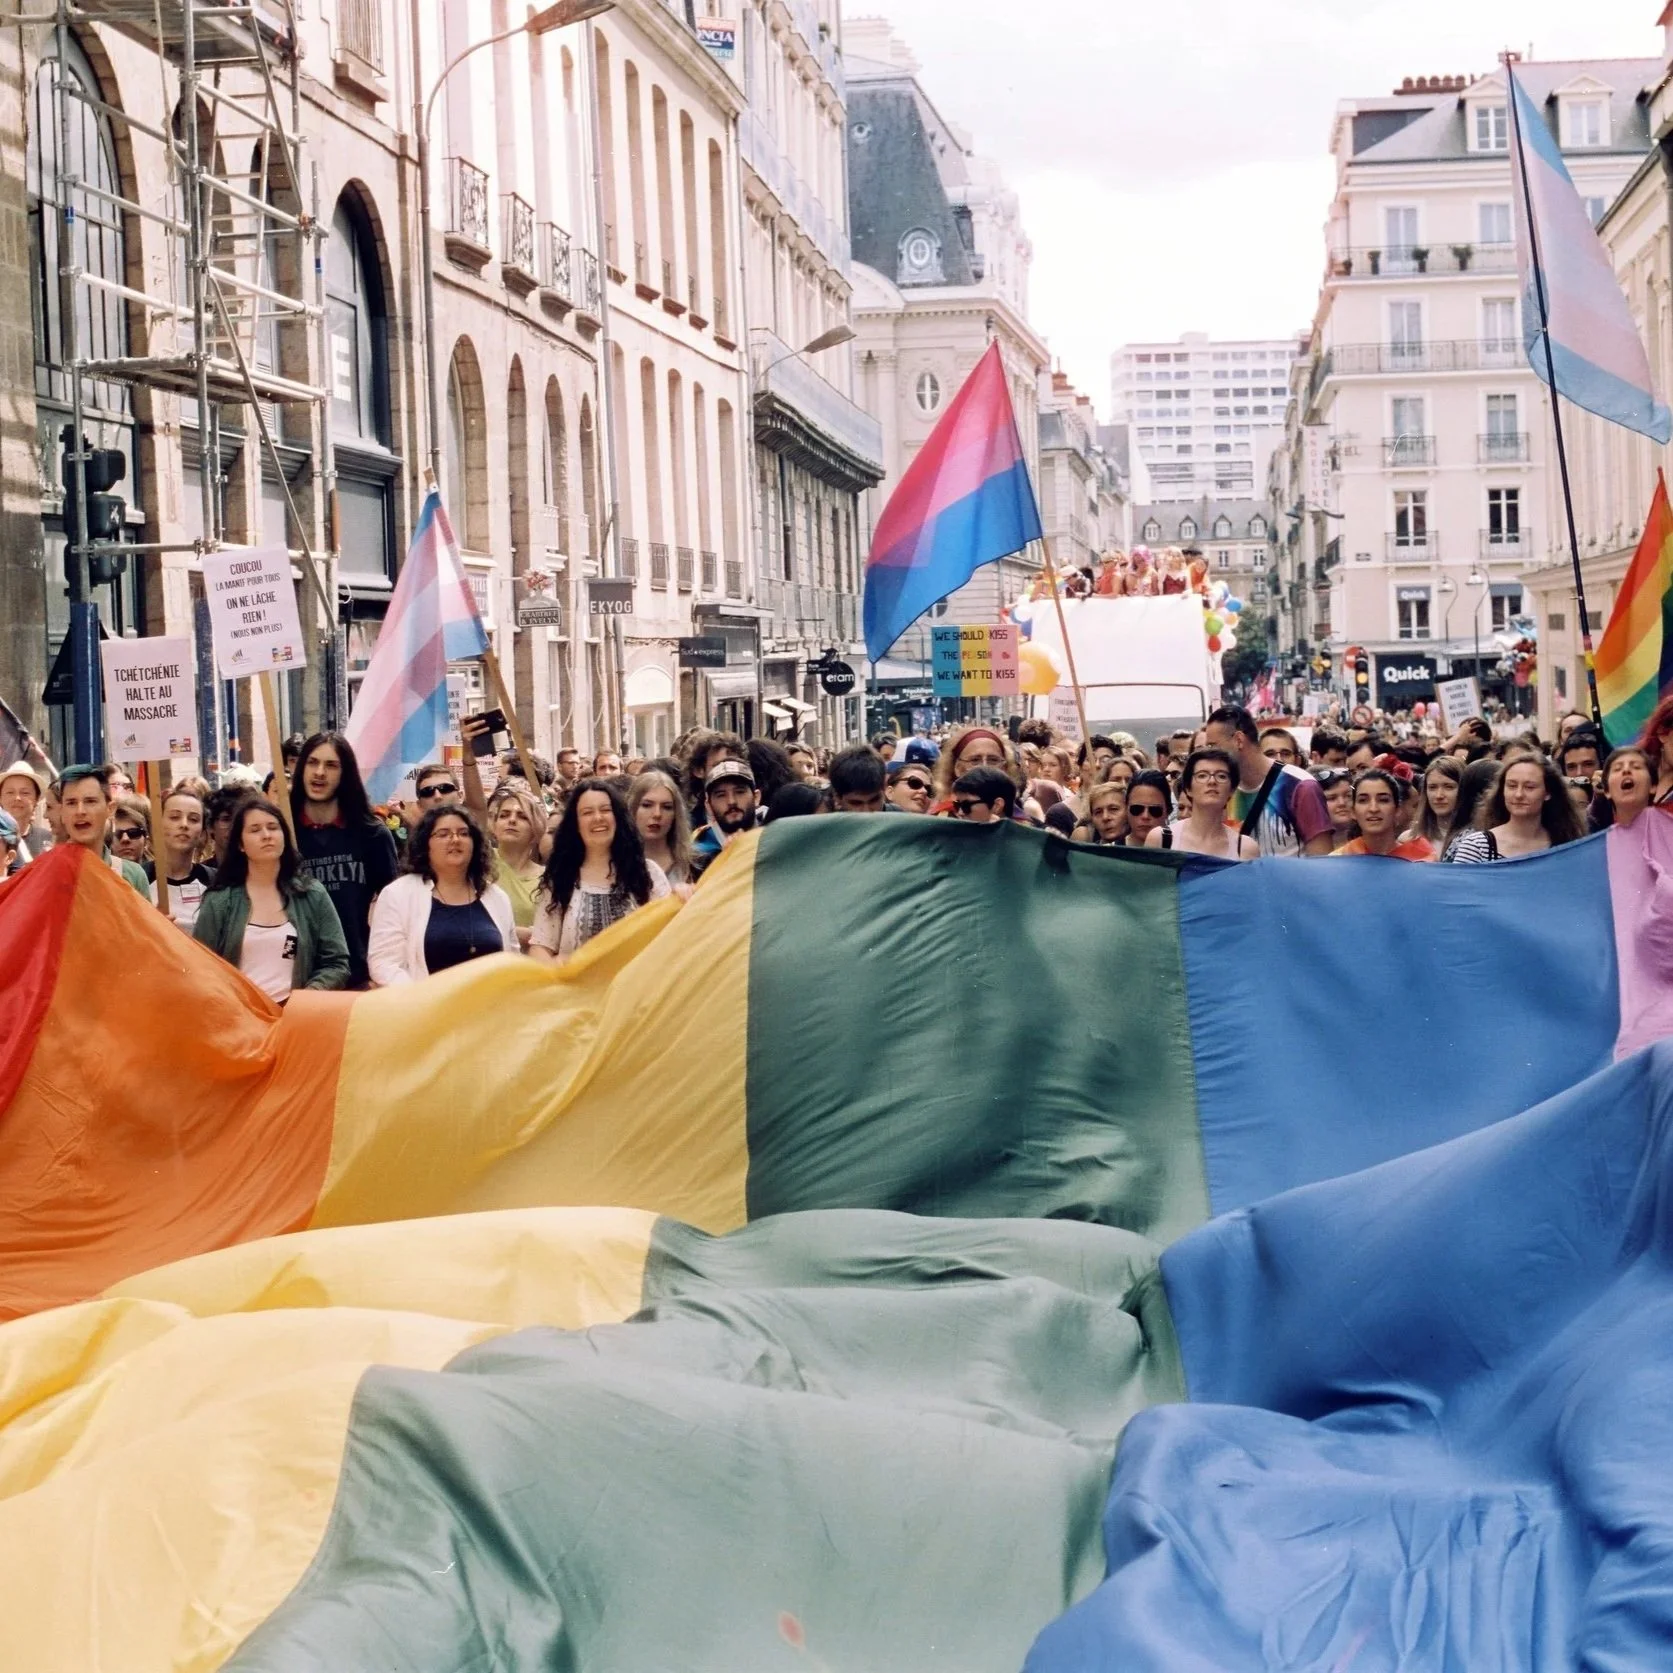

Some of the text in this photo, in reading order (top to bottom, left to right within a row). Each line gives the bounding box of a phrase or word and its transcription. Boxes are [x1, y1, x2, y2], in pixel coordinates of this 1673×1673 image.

[1322, 459, 1330, 508] HOTEL
[230, 560, 262, 575] COUCOU
[216, 573, 281, 591] LA MANIF POUR TOUS
[226, 591, 277, 610] ON NE LÂCHE
[1401, 589, 1426, 600] Quick
[590, 600, 632, 614] EKYOG
[242, 611, 261, 624] RIEN
[251, 626, 263, 637] NON
[935, 629, 1008, 641] WE SHOULD KISS
[942, 651, 958, 660] THE
[114, 664, 180, 682] TCHÉTCHÉNIE
[826, 674, 855, 682] eram
[937, 669, 1015, 681] WE WANT TO KISS
[1383, 665, 1430, 683] Quick
[126, 685, 172, 701] HALTE AU
[124, 704, 178, 721] MASSACRE
